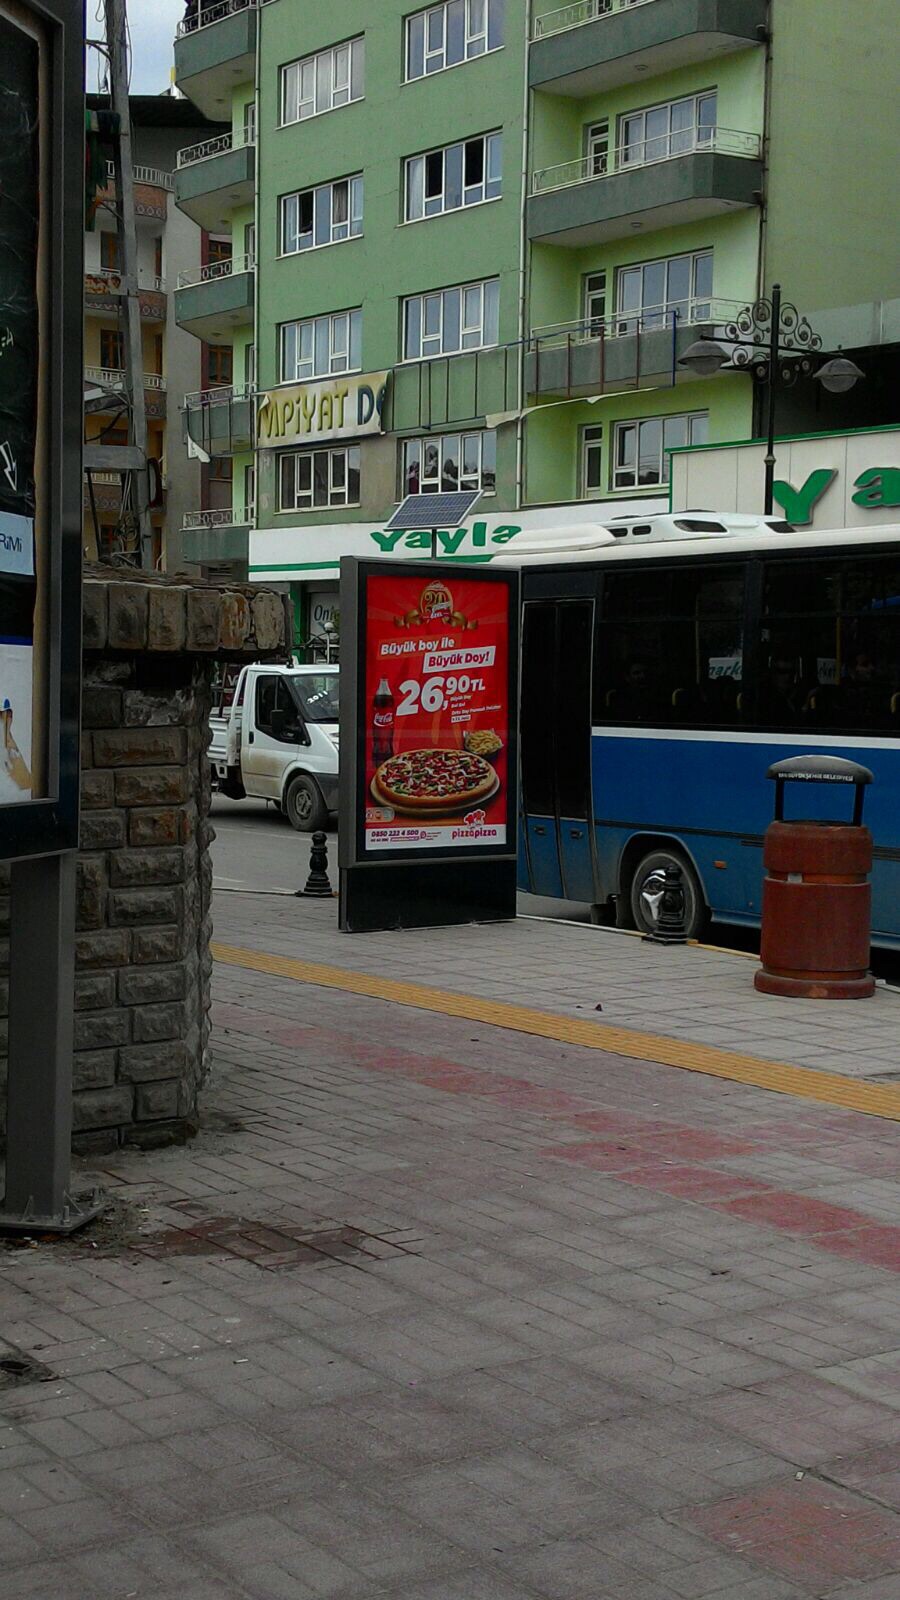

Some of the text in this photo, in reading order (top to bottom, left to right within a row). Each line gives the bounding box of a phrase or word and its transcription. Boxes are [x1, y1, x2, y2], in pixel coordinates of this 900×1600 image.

[370, 522, 522, 553] Yayla
[381, 637, 455, 656] Büyük boy ile
[428, 651, 490, 667] Büyük Doy!
